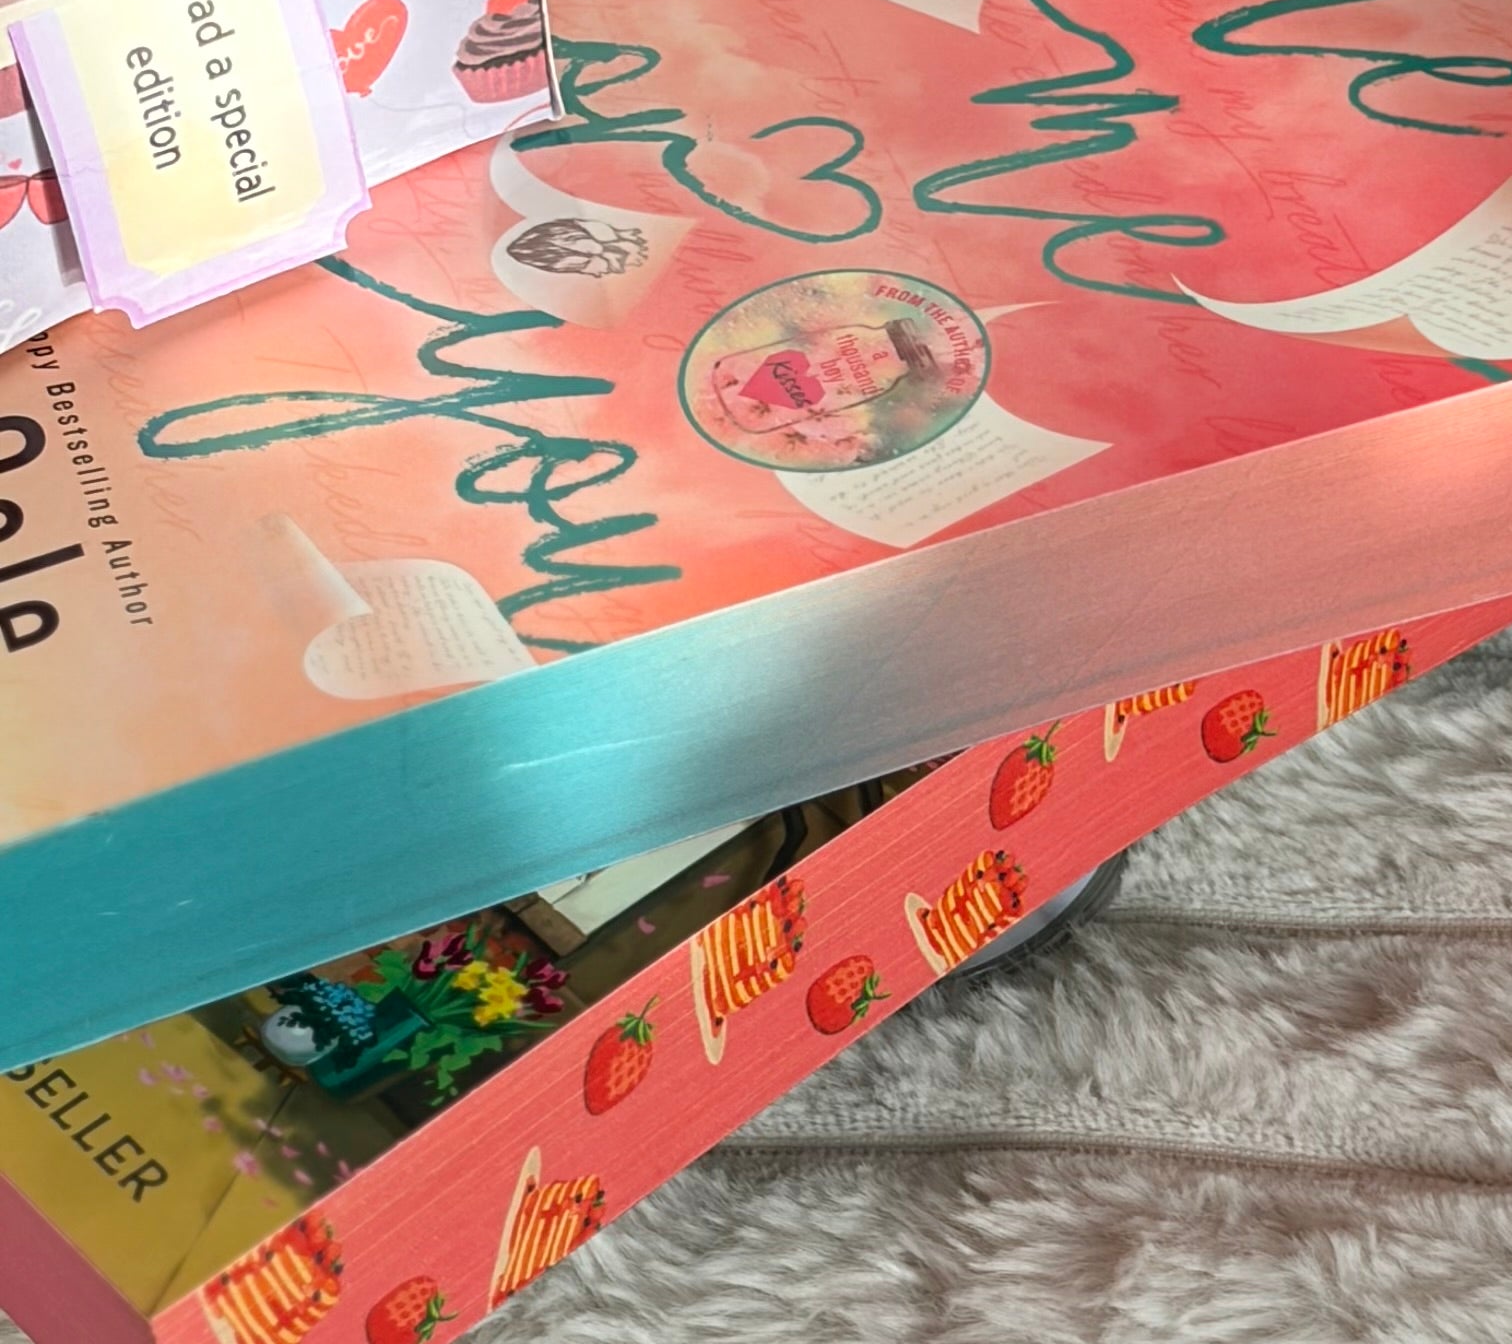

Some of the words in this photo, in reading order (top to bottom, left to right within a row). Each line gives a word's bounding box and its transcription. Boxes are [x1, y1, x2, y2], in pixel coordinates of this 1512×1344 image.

[205, 56, 233, 81] a
[337, 14, 399, 74] ove
[126, 45, 182, 170] edition
[210, 87, 277, 203] special
[874, 284, 927, 308] FROM
[924, 301, 954, 326] THE
[819, 358, 845, 385] boy
[835, 333, 884, 397] thousand
[871, 351, 889, 362] a
[46, 381, 119, 529] Bestselling
[101, 539, 154, 627] Author
